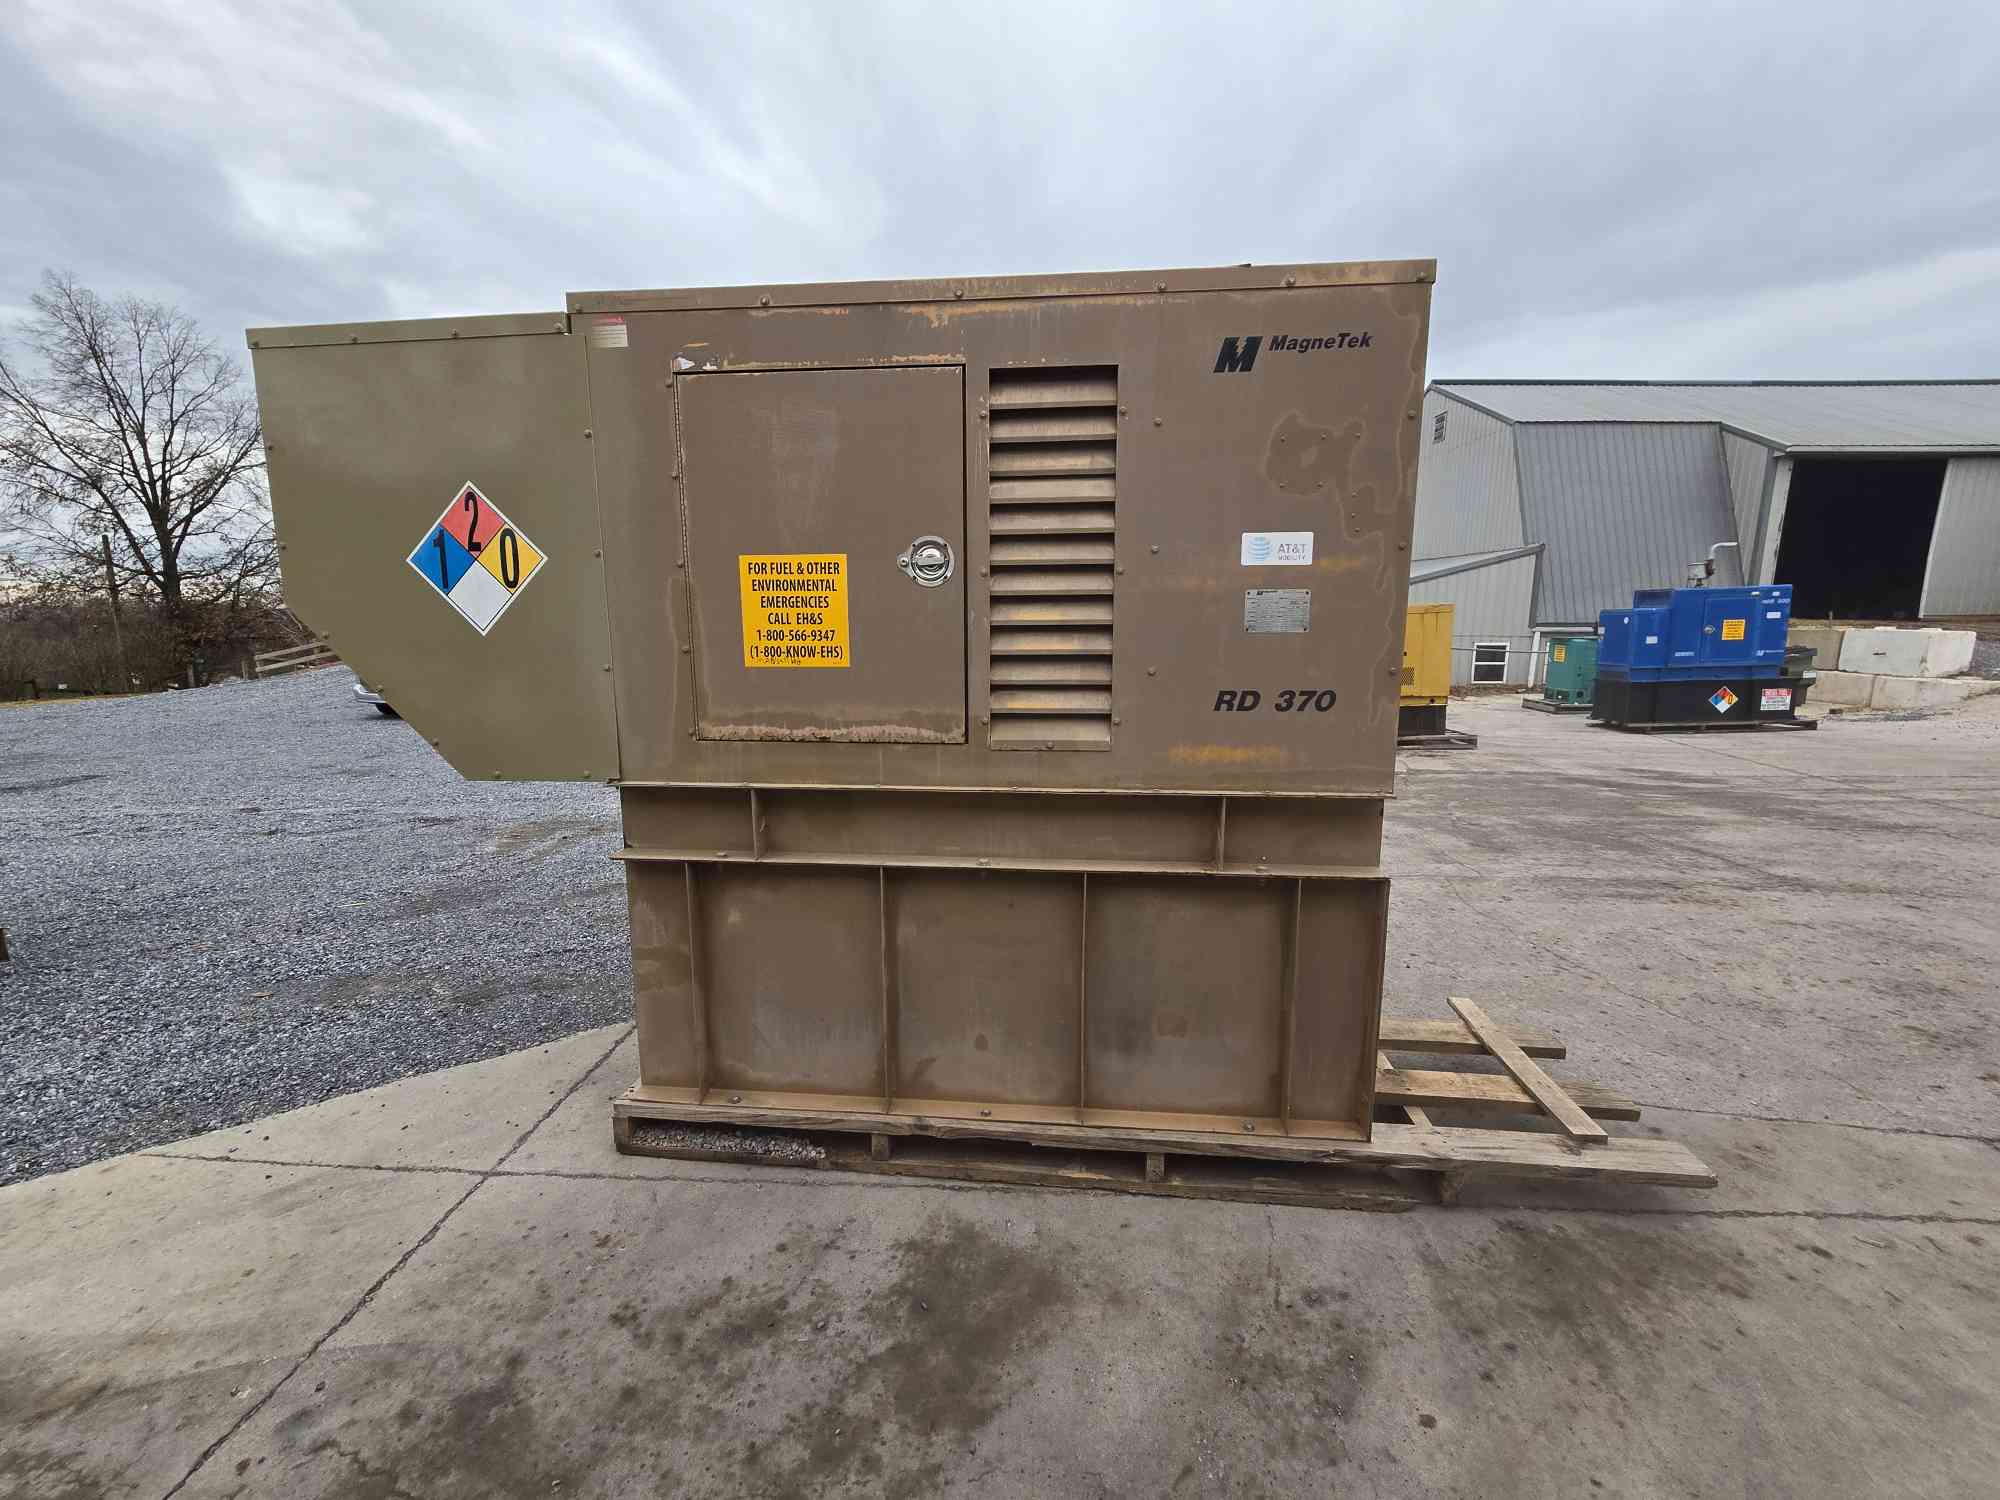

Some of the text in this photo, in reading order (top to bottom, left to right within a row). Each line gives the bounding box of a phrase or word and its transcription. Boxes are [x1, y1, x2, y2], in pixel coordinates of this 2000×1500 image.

[1269, 332, 1374, 353] MagneTek
[464, 491, 481, 552] 2
[1278, 543, 1307, 554] AT&T
[433, 528, 449, 589] 1
[500, 528, 520, 589] 0
[748, 562, 840, 575] FOR FUEL & OTHER
[752, 579, 838, 592] ENVIRONMENTAL
[760, 596, 829, 609] EMERGENCIES
[768, 612, 823, 625] CALL EH&S
[757, 629, 835, 641] 1-800-566-9347
[750, 645, 843, 660] (1-800-KNOW-EHS)
[1214, 690, 1336, 712] RD 370
